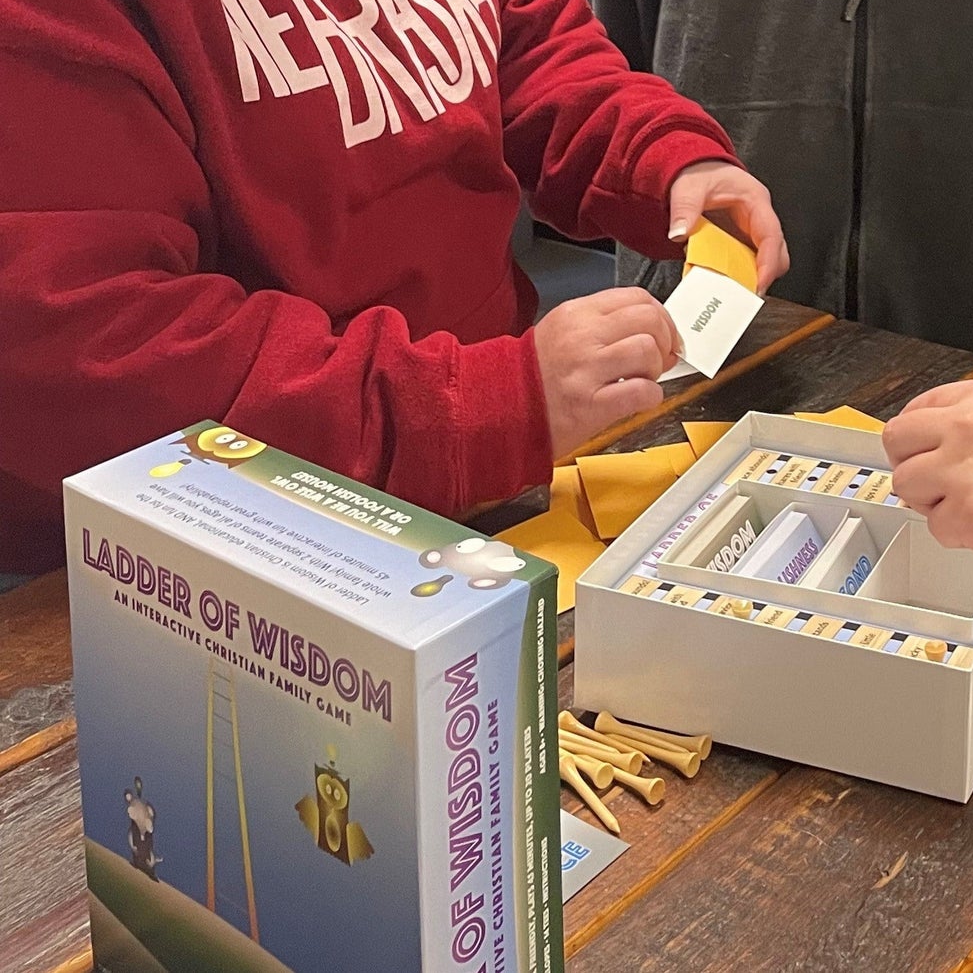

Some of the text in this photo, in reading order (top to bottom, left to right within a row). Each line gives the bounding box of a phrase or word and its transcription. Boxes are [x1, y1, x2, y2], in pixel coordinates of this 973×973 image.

[690, 297, 722, 333] WISDOM
[145, 483, 174, 496] have
[266, 475, 406, 536] WILL YOU BE A WISE OWL
[289, 470, 416, 525] OR A FOOLISH MOUSE?
[227, 504, 259, 519] great
[249, 515, 276, 528] with
[268, 524, 291, 534] fun
[236, 525, 270, 541] teams
[262, 536, 309, 558] separate
[282, 530, 335, 555] interactive
[285, 564, 329, 586] Wisdom
[305, 557, 335, 571] With
[337, 555, 380, 575] minutes
[331, 586, 372, 606] Ladder
[358, 581, 394, 599] whole
[81, 526, 393, 724] LADDER OF WISDOM
[114, 588, 352, 728] AN INTERACTIVE CHRISTIAN FAMILY GAME
[538, 682, 546, 733] WARNING:
[524, 725, 533, 774] PLAYERS
[445, 651, 486, 963] OF WISDOM
[488, 697, 503, 931] CHRISTIAN FAMILY GAME
[526, 820, 534, 873] MINUTES,
[541, 836, 549, 903] INSTRUCTIONS
[527, 884, 536, 919] PLAYS
[528, 917, 537, 969] FRIENDLY,
